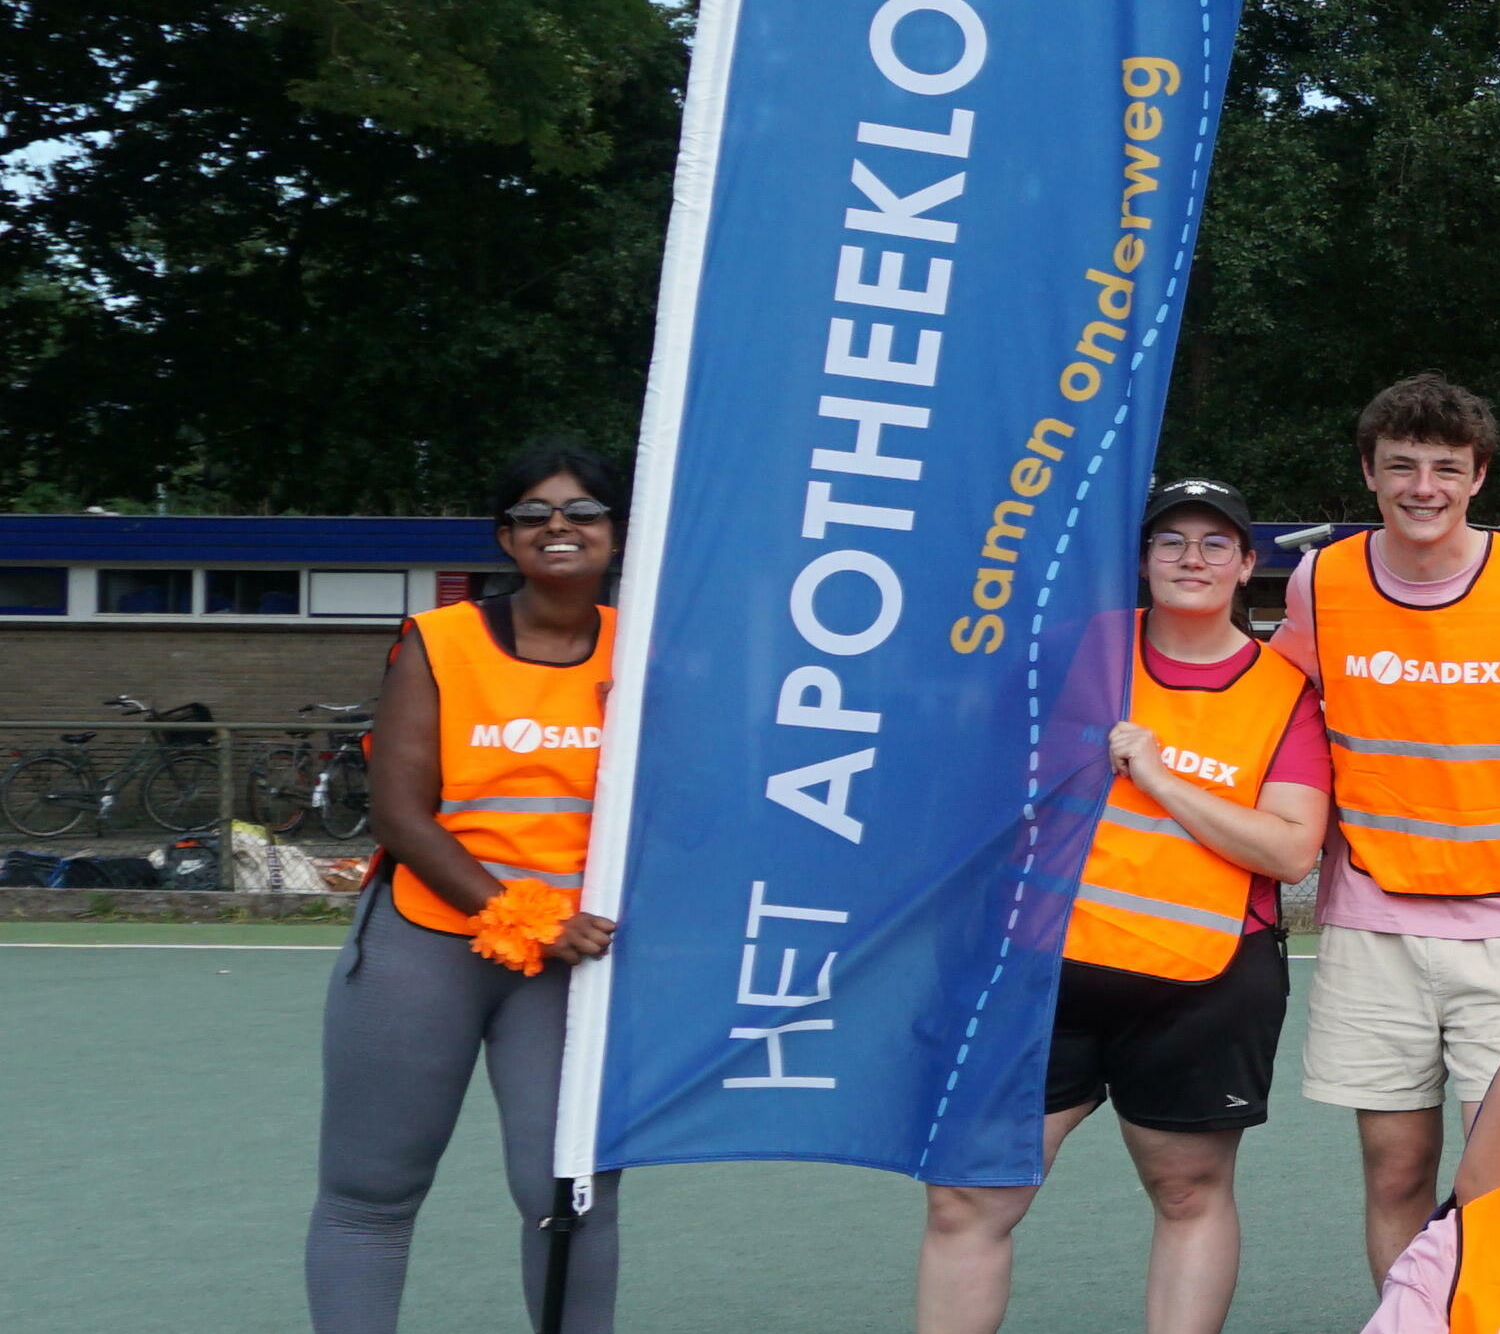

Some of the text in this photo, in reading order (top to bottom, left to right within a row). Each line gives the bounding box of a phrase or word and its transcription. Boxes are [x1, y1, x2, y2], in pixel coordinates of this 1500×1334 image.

[950, 55, 1181, 655] Samen onderweg
[722, 880, 850, 1089] HET
